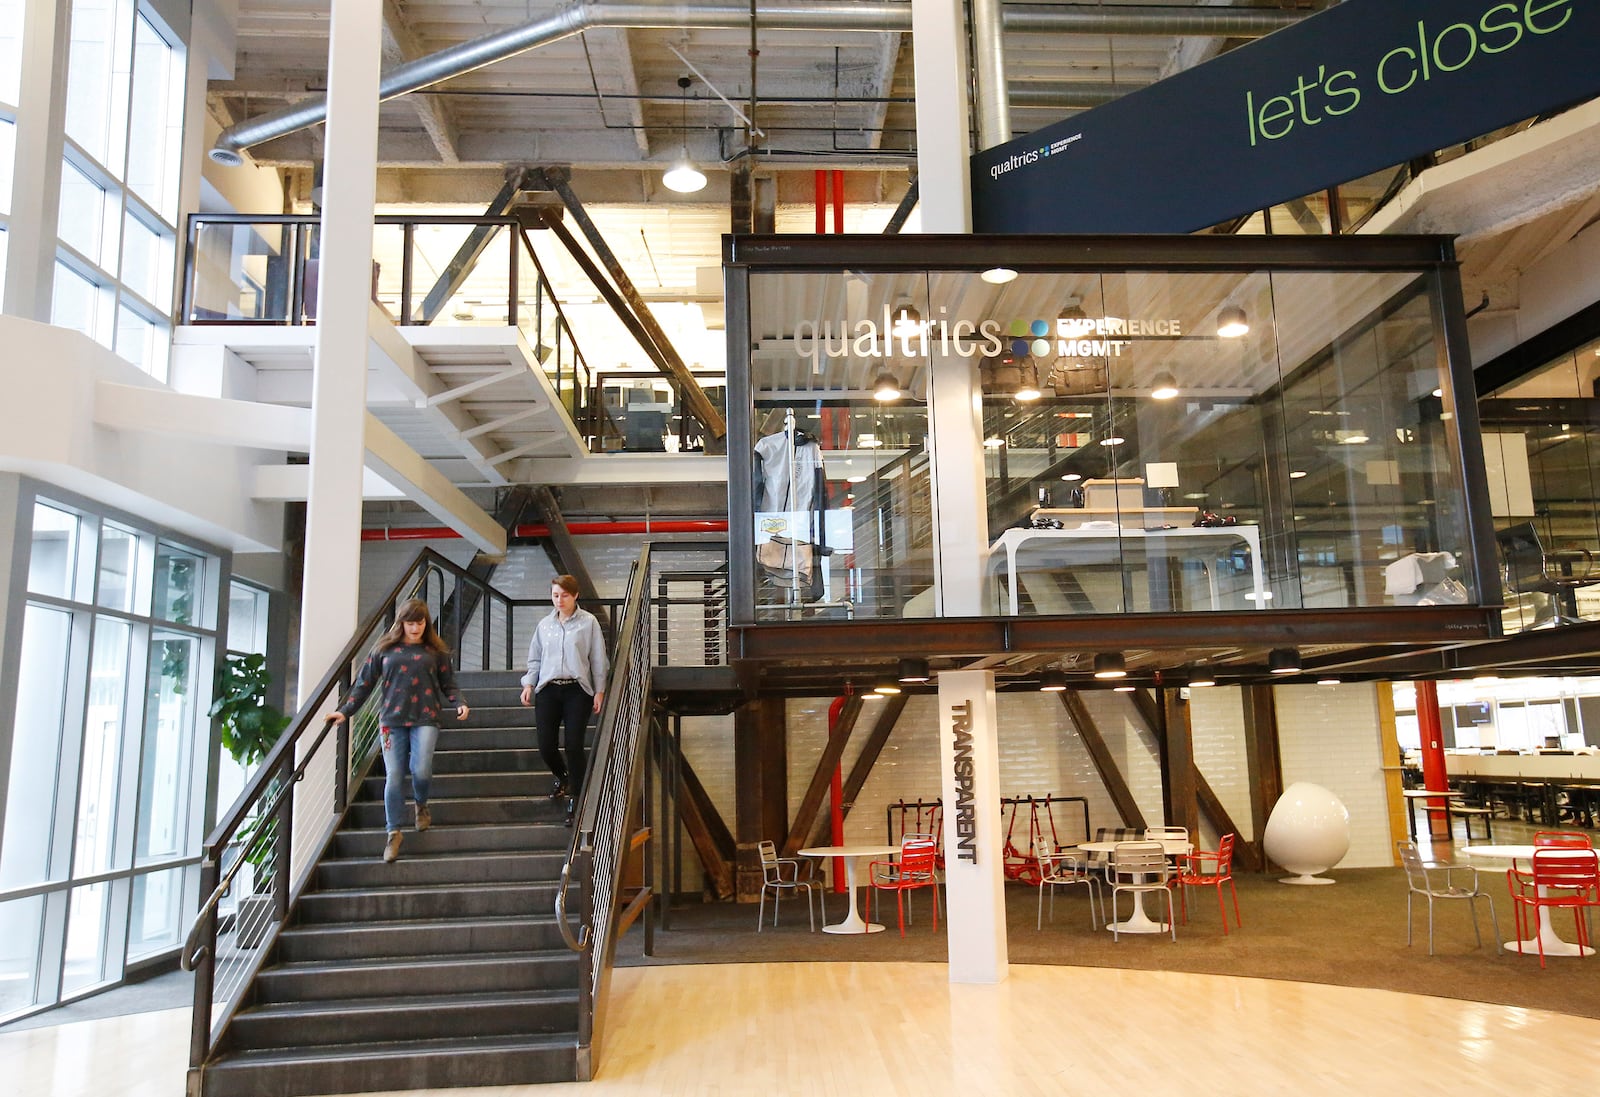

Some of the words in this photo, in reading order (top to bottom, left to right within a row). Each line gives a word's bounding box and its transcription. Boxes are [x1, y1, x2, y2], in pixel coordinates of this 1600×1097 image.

[1246, 64, 1361, 147] let's
[1377, 0, 1573, 94] close
[1050, 132, 1082, 150] EXPERIENCE
[1050, 144, 1068, 155] MGMT
[990, 150, 1039, 180] qualtrics
[793, 303, 1003, 375] qualtrics
[1056, 317, 1182, 336] EXPERIENCE
[951, 699, 977, 865] TRANSPARENT
